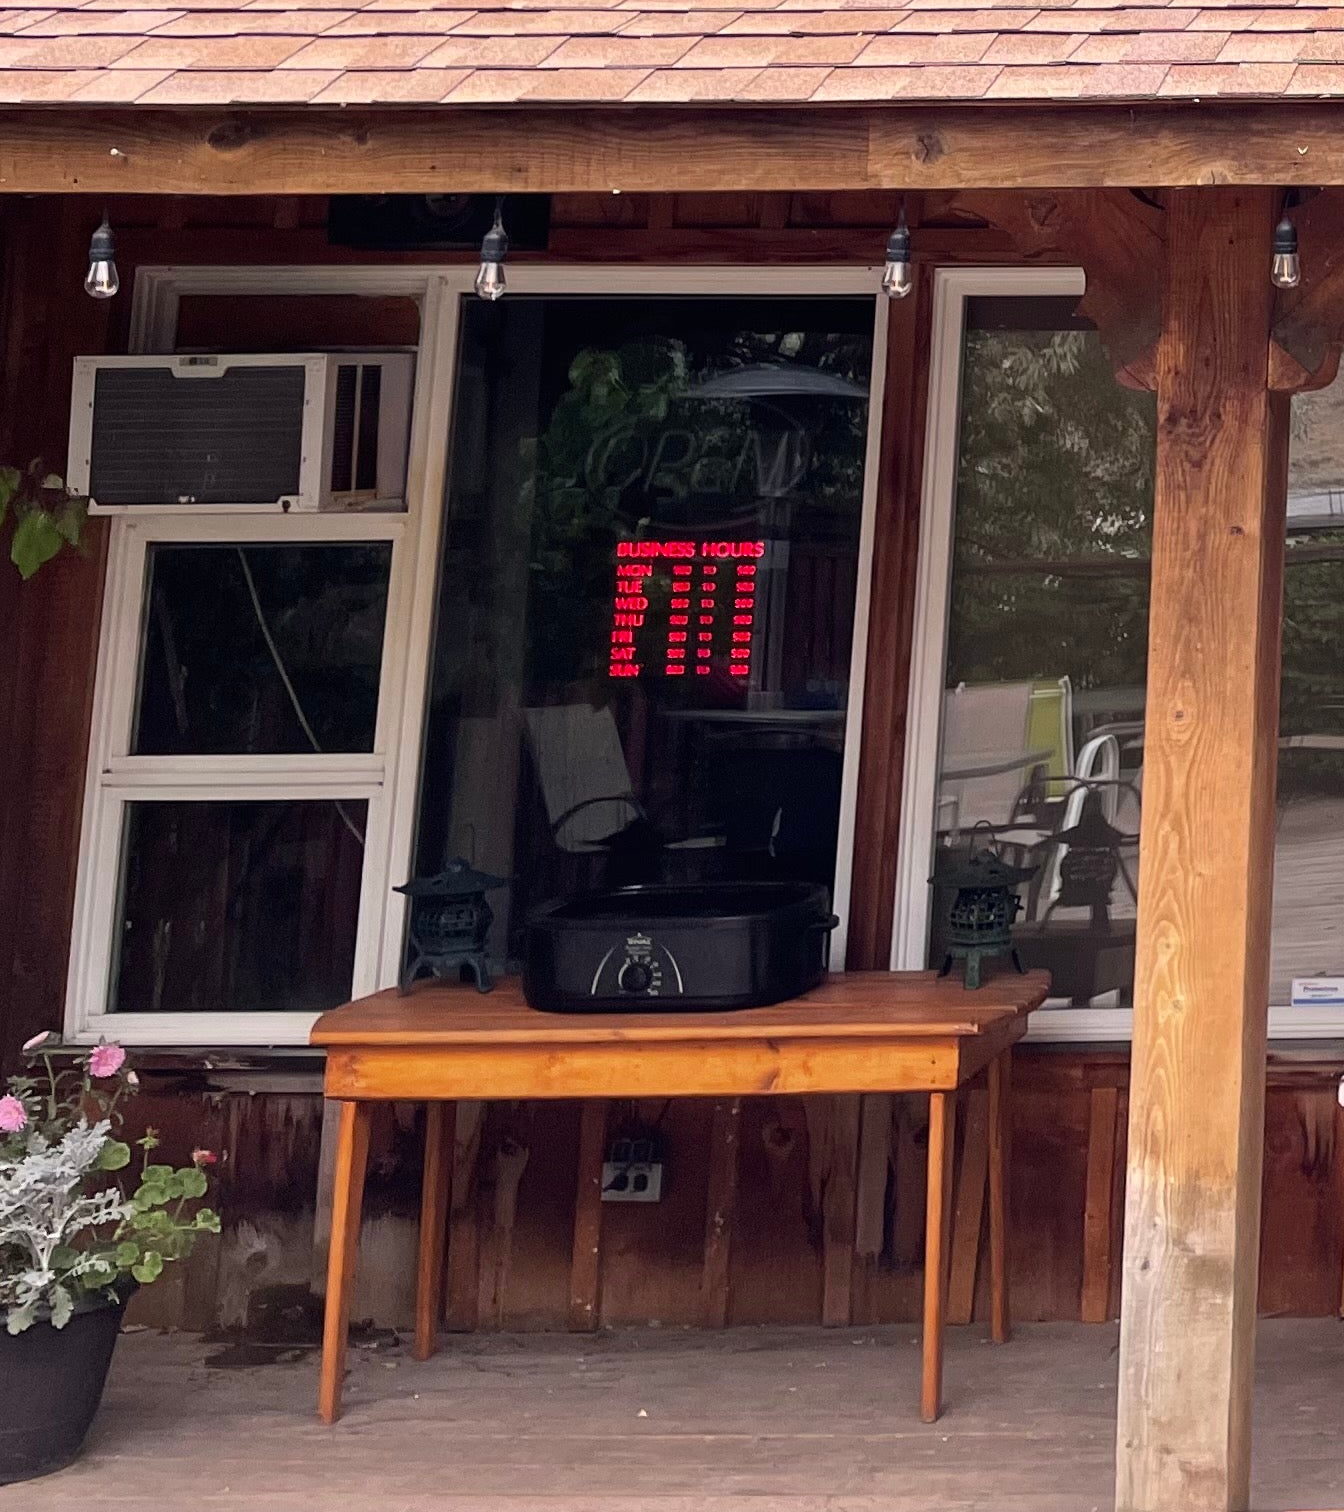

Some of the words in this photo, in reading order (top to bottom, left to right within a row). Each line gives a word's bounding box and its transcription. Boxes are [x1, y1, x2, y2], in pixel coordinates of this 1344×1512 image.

[616, 541, 696, 558] BUSINESS
[701, 541, 765, 558] HOURS
[616, 580, 643, 593] TUE
[610, 647, 637, 660] SAT
